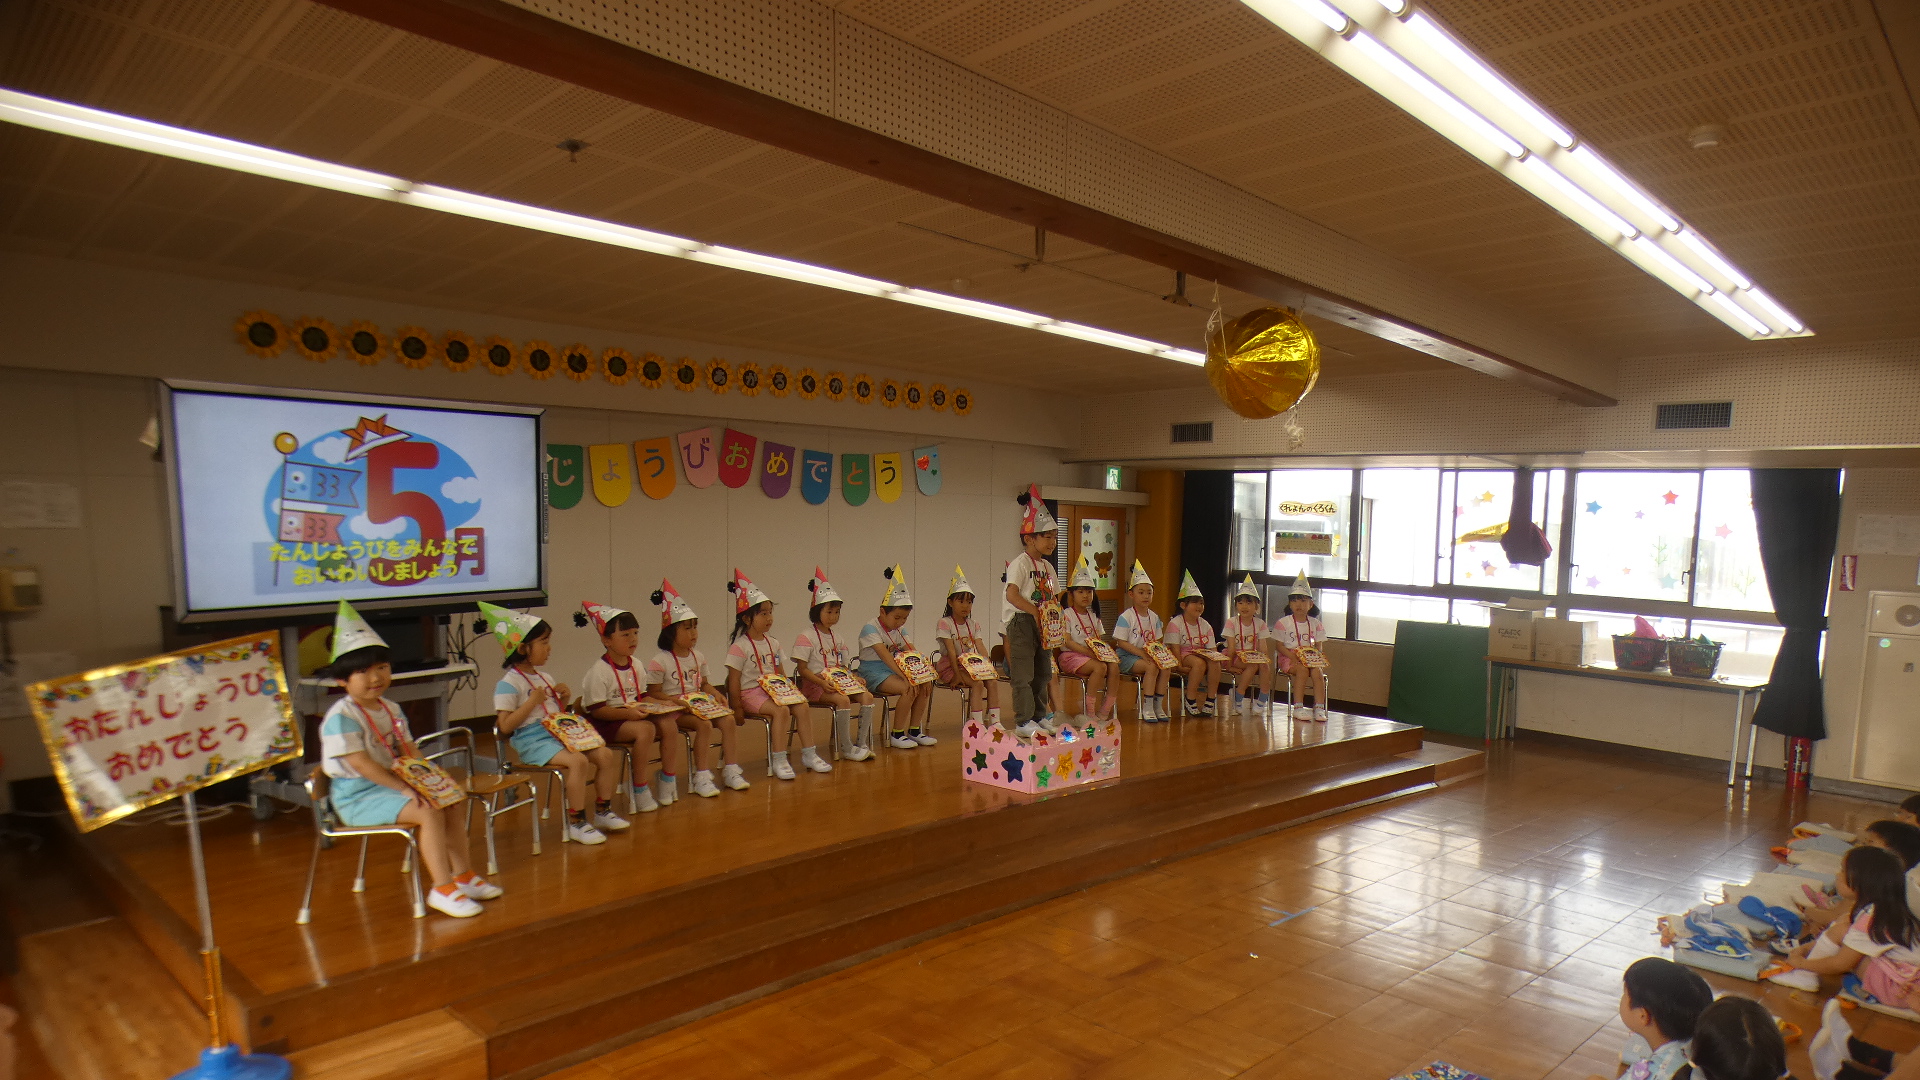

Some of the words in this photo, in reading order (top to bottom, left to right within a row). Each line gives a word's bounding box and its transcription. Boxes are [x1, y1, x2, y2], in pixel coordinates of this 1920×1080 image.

[1279, 503, 1337, 513] くれよんのくろくん
[269, 538, 478, 562] たんじょうびをみんなで
[292, 560, 458, 585] おいわいしましょう
[64, 667, 267, 742] おたんじょうび
[106, 717, 249, 782] おめでとう
